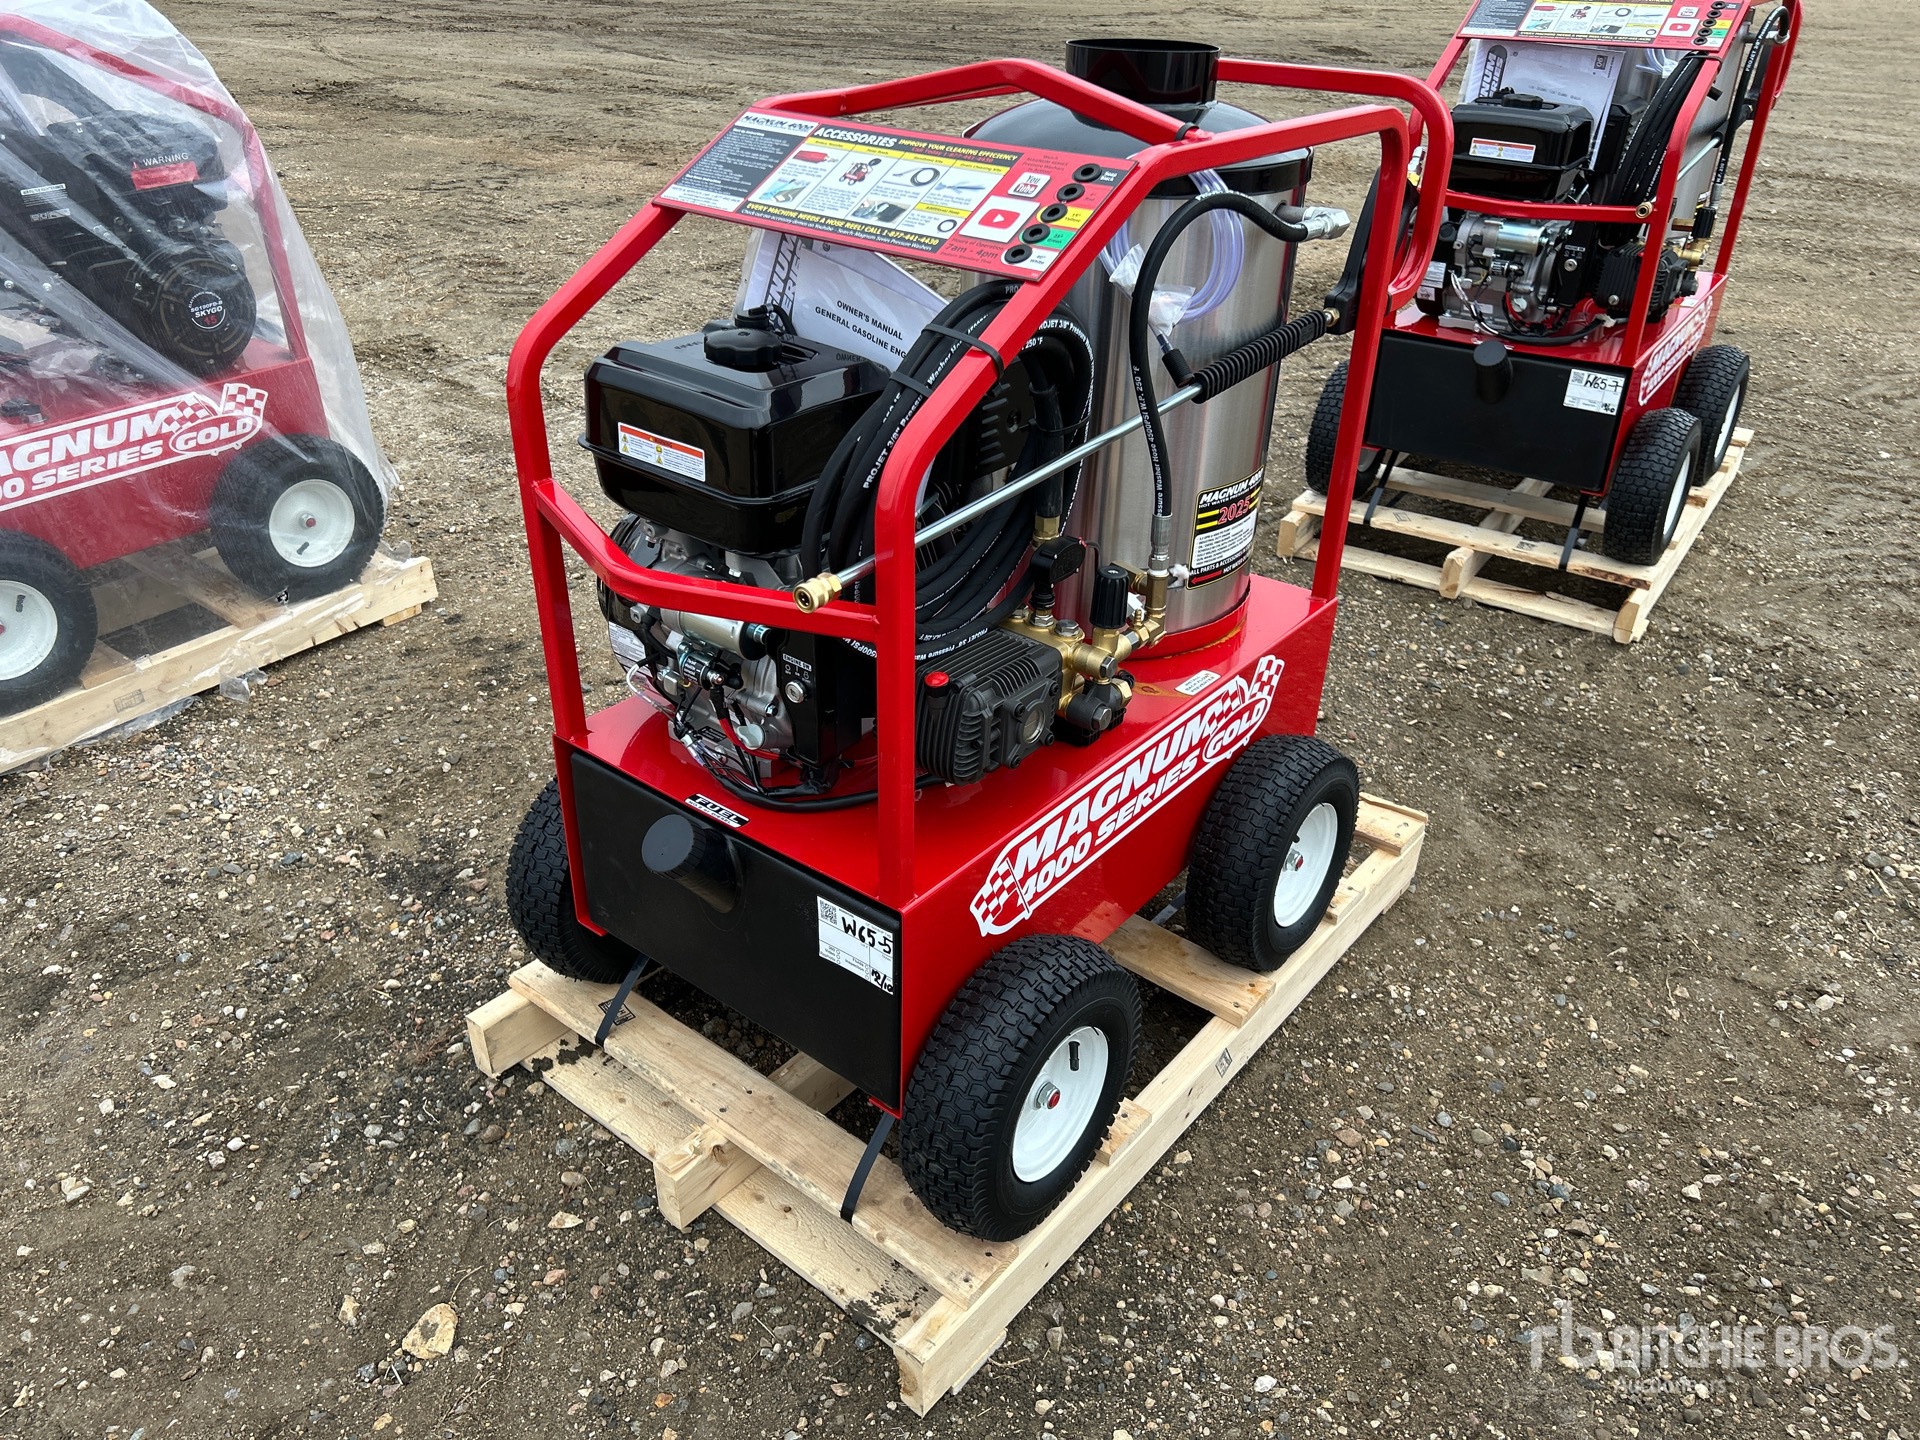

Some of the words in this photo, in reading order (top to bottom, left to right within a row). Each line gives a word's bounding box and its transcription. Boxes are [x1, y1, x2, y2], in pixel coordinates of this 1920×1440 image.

[1480, 52, 1497, 98] NUM
[814, 127, 898, 148] ACCESSORIES
[143, 153, 189, 166] WARNING
[898, 139, 927, 150] IMPROVE
[928, 142, 944, 152] YOUR
[945, 144, 977, 157] CLEANING
[977, 149, 1019, 162] EFFICIENCY
[1016, 184, 1038, 194] Tube
[1026, 174, 1040, 184] You
[746, 203, 769, 213] EVERY
[768, 206, 798, 218] MACHINE
[798, 212, 820, 223] NEEDS
[826, 219, 844, 228] HOSE
[865, 226, 881, 235] CALL
[882, 229, 940, 246] 1-877-441-4430
[854, 232, 876, 241] Magnum
[890, 238, 911, 247] Pressure
[912, 242, 932, 250] Washers
[946, 243, 968, 254] 7am
[976, 249, 998, 260] 4pm
[976, 242, 1004, 252] Operation
[195, 306, 223, 318] SKYGO
[836, 300, 870, 323] OWNER'S
[871, 318, 904, 341] MANUAL
[815, 306, 850, 329] GENERAL
[852, 324, 889, 351] GASOLINE
[1025, 338, 1036, 350] 250
[1134, 376, 1144, 392] 250
[862, 448, 888, 489] PROJET
[926, 352, 951, 385] Washer
[1142, 412, 1155, 443] 4500PSI
[32, 440, 164, 491] SERIES
[175, 418, 251, 452] GOLD
[1150, 443, 1160, 462] Hose
[1154, 464, 1164, 491] Washer
[1200, 479, 1249, 504] MAGNUM
[1218, 495, 1252, 526] 2025
[1200, 564, 1215, 574] PARTS
[928, 645, 956, 658] Pressure
[1014, 698, 1222, 879] MAGNUM
[695, 797, 739, 823] FUEL
[1017, 831, 1093, 906] 4000
[1094, 748, 1201, 846] SERIES
[1210, 702, 1264, 756] GOLD
